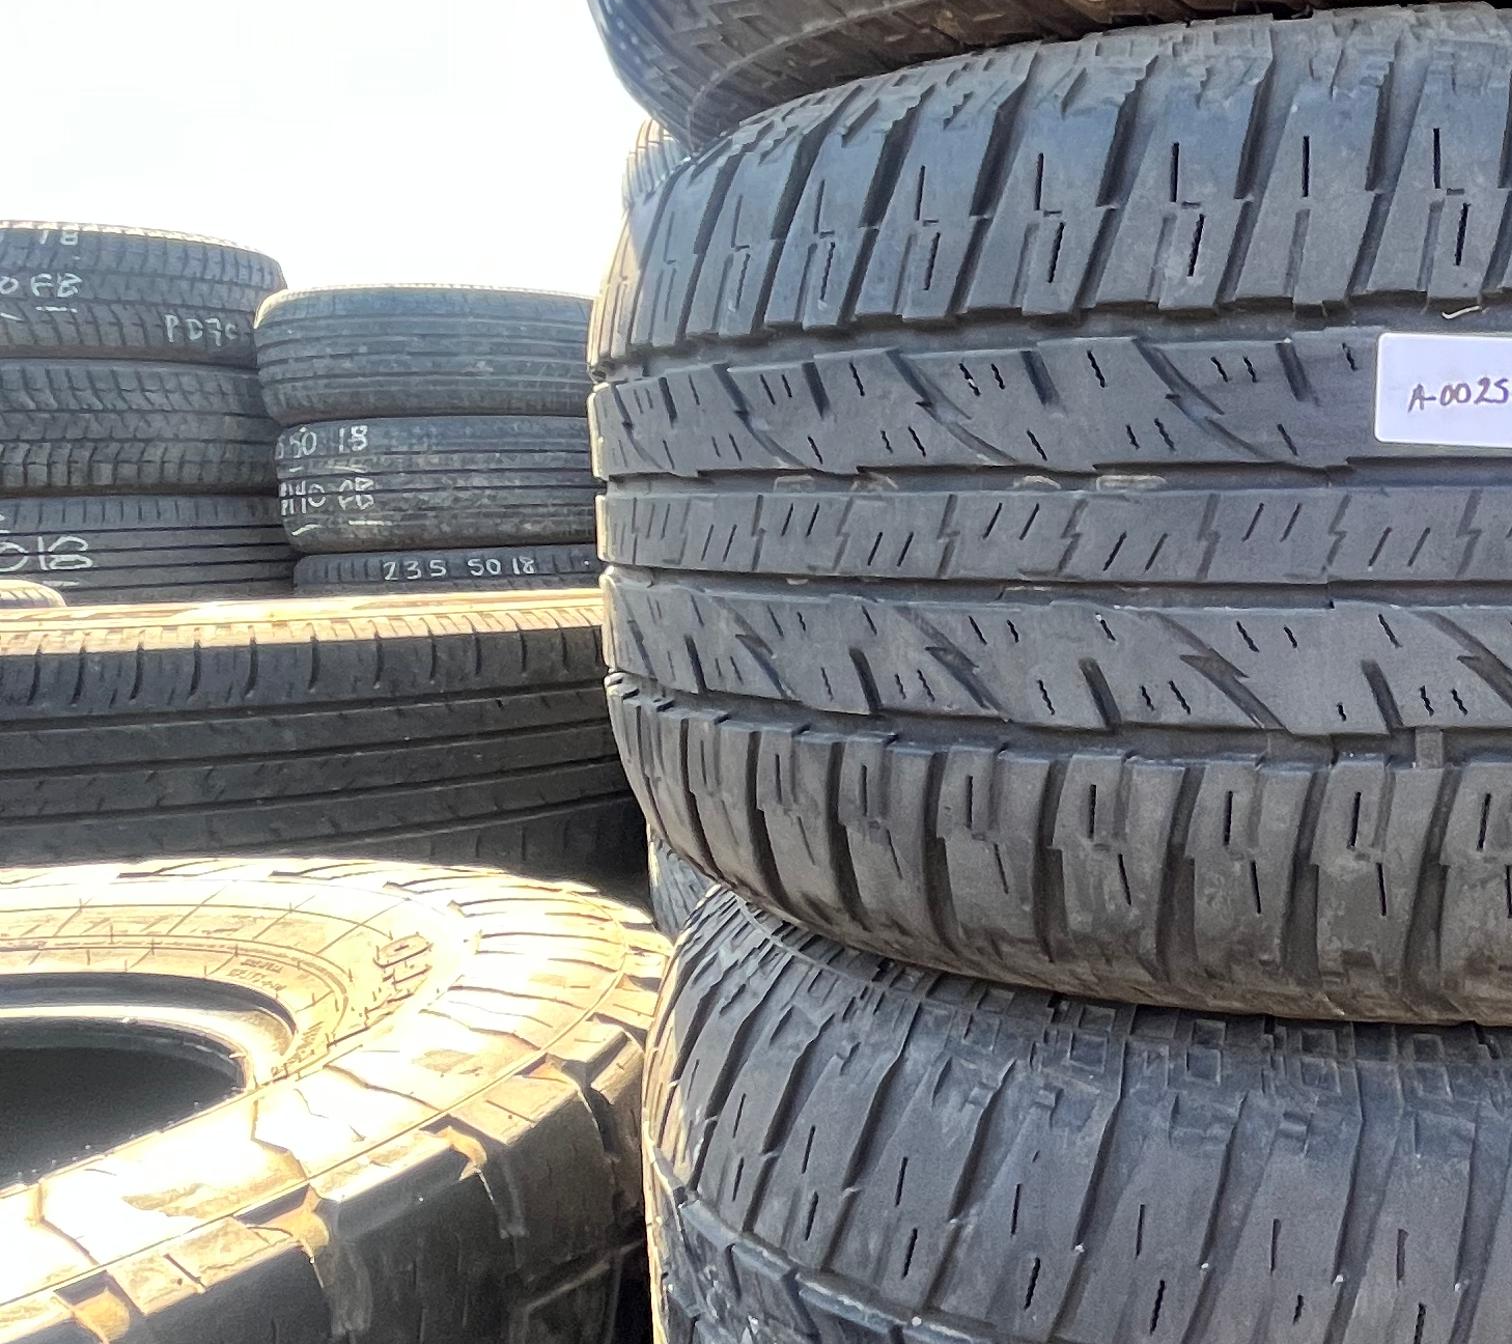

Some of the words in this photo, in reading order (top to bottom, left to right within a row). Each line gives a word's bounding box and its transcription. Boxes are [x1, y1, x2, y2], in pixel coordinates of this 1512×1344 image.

[382, 559, 448, 582] 235
[466, 556, 502, 577] 50
[512, 555, 536, 575] 18
